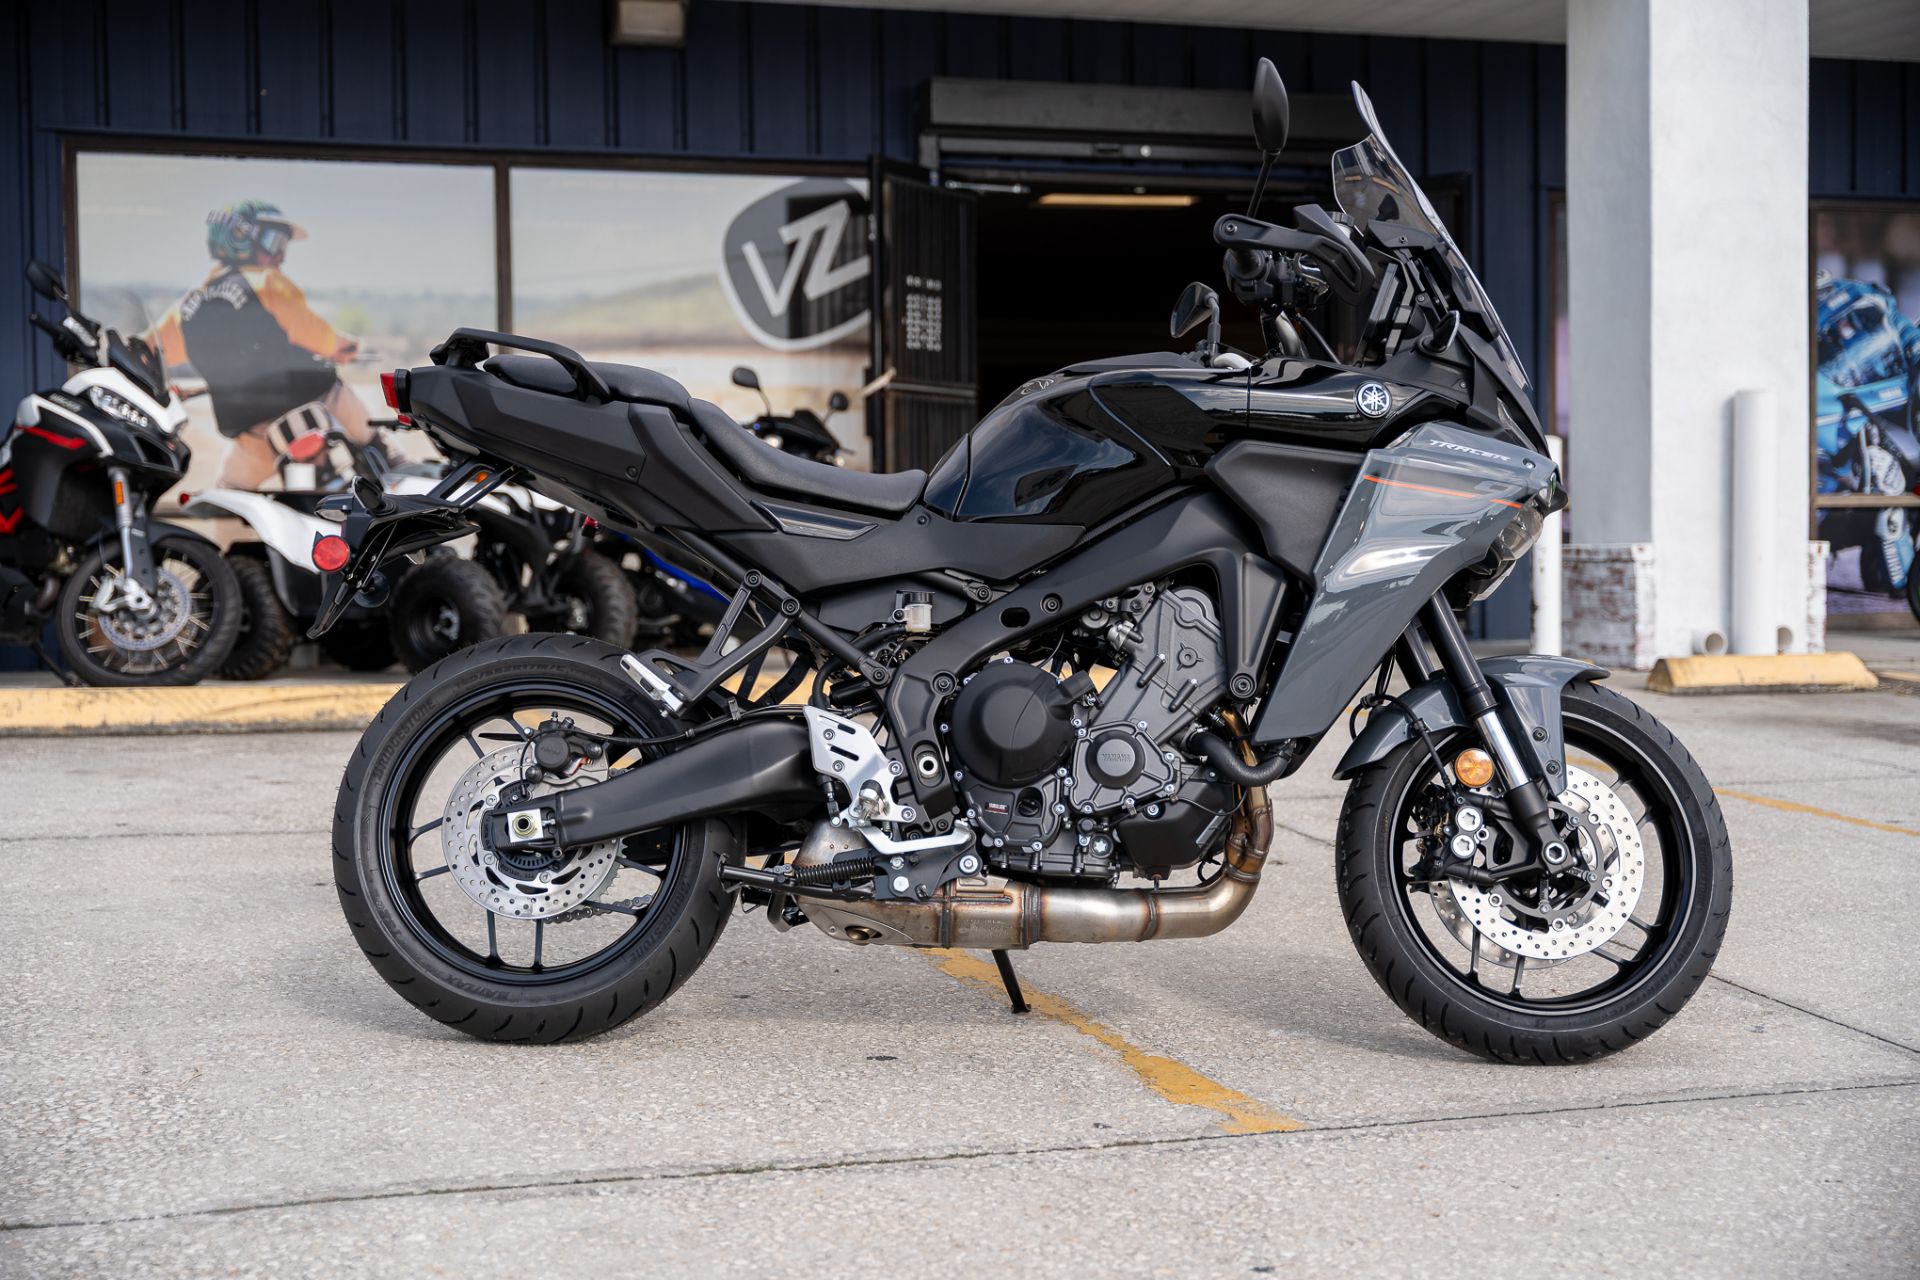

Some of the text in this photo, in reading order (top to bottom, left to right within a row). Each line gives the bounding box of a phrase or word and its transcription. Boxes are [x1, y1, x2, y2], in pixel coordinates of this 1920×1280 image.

[1429, 439, 1511, 462] TRACER
[371, 696, 438, 782] BRIDGESTONE
[1101, 752, 1132, 762] YAMAHA
